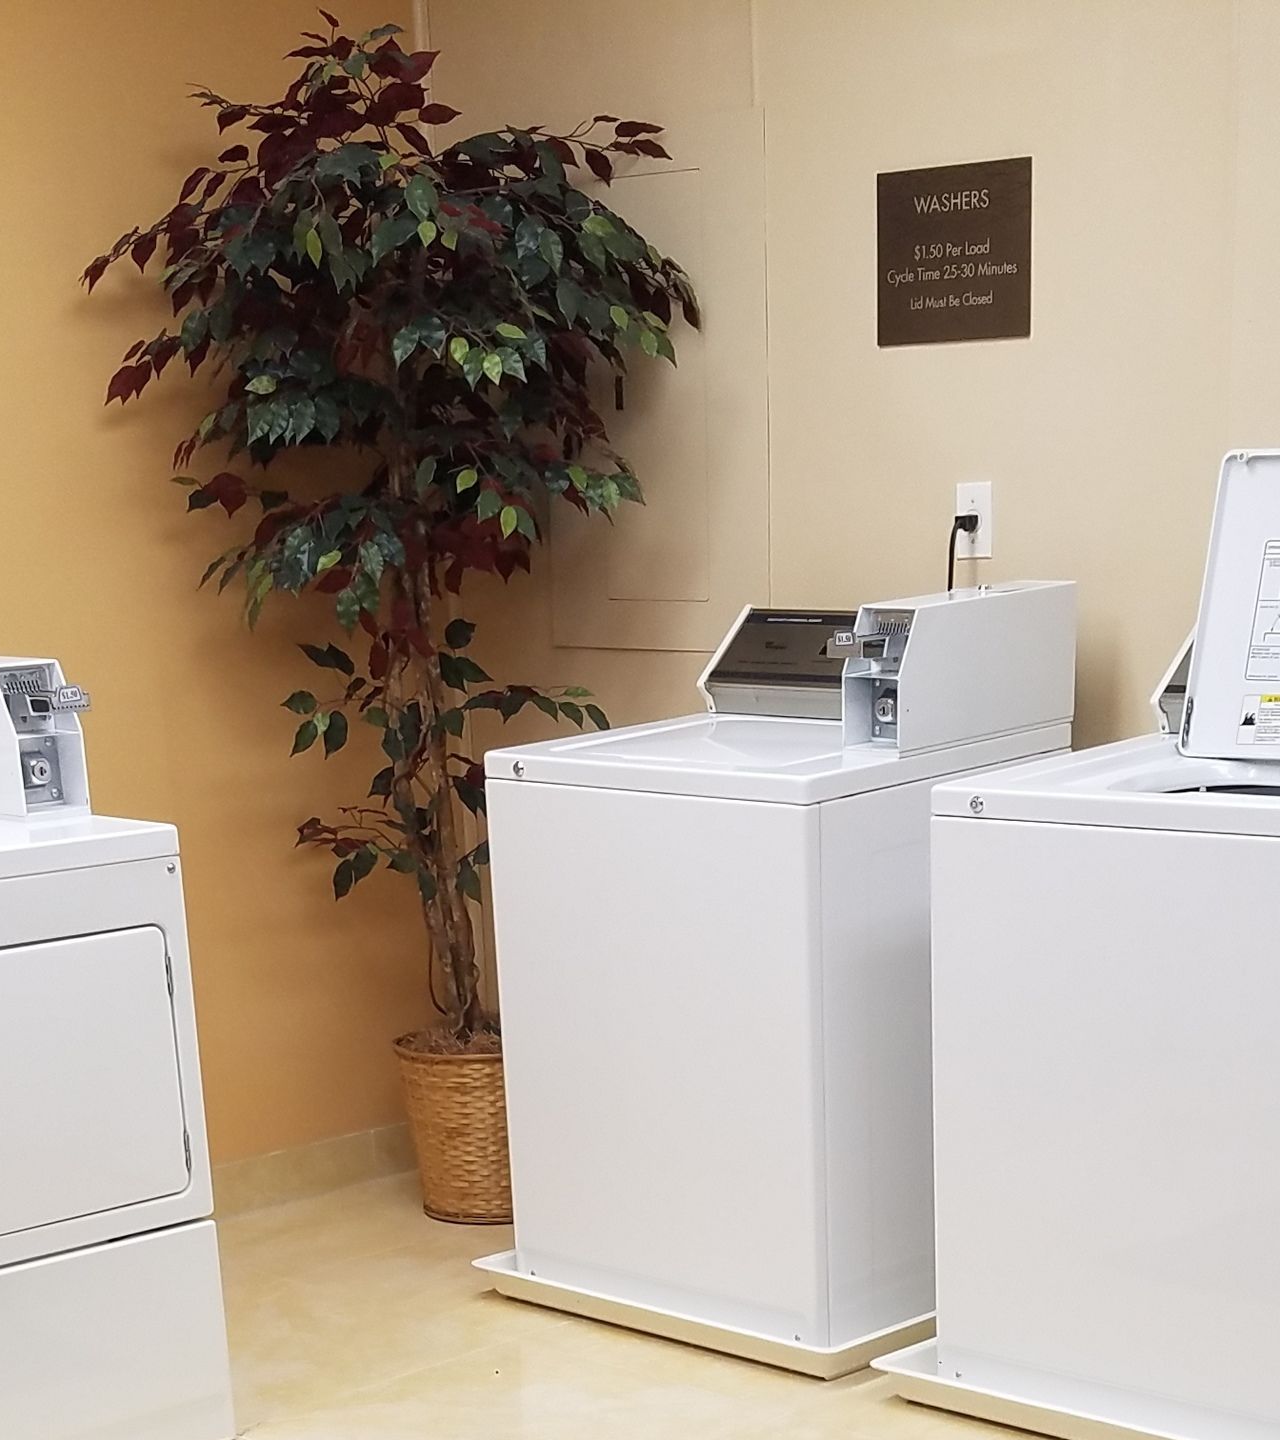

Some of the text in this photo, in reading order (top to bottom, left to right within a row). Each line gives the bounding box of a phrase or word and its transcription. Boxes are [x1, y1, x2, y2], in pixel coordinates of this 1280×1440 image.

[914, 189, 989, 214] WASHERS
[914, 238, 990, 260] $1.50 Per Load
[888, 262, 1018, 287] Cycle Time 25-30 Minutes
[911, 290, 993, 310] Lid Must Be Closed
[62, 691, 77, 699] $1.50
